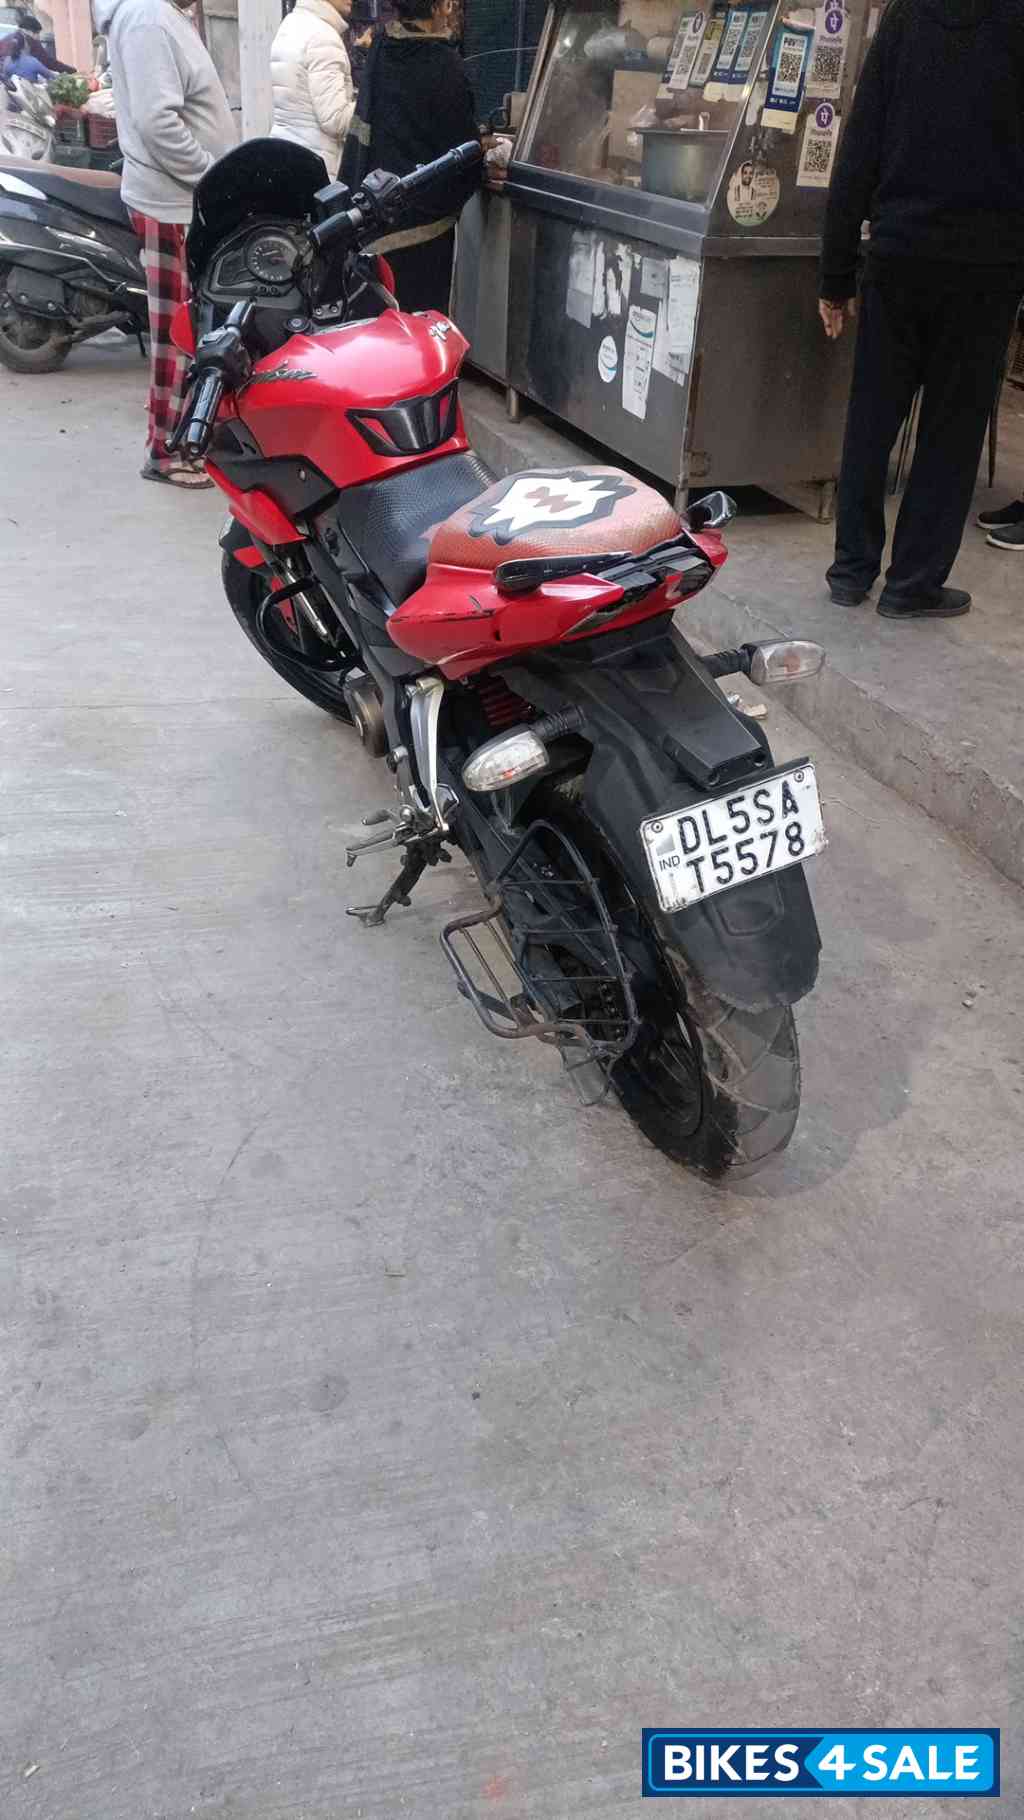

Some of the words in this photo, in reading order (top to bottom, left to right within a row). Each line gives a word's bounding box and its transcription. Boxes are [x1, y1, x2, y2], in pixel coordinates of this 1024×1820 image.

[677, 780, 799, 854] DL5SA
[659, 855, 681, 872] IND
[686, 821, 804, 893] T5578
